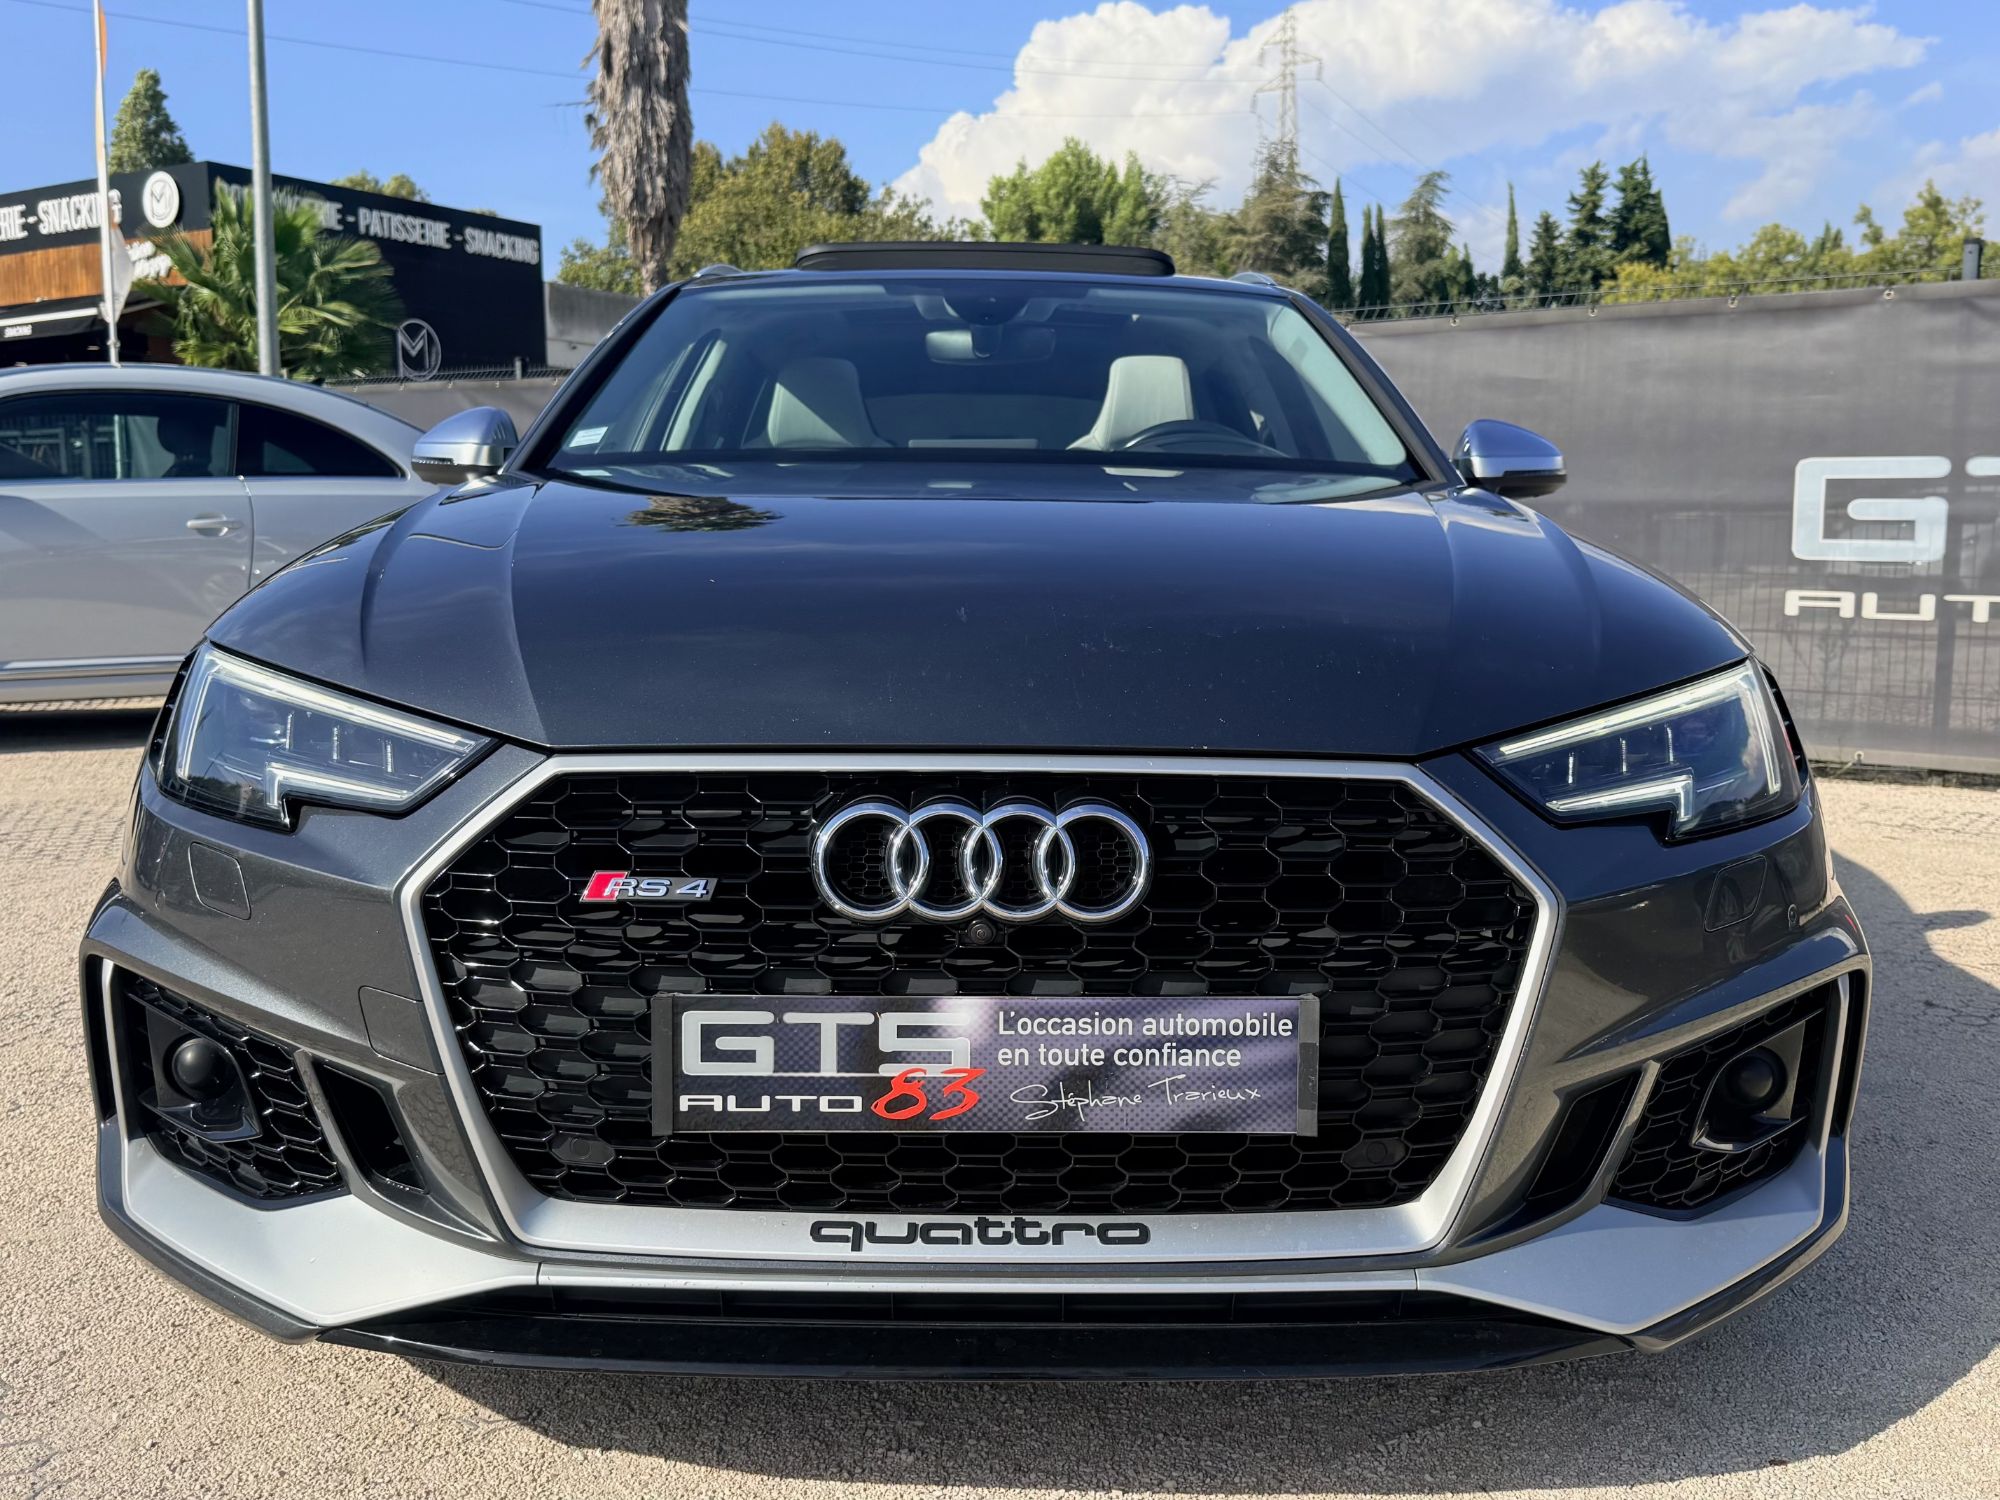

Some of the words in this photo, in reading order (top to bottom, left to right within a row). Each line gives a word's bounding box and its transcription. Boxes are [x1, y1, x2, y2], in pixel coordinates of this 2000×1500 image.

[38, 188, 122, 235] SNACKIG
[358, 207, 452, 250] PATISSERIE
[464, 226, 540, 266] SNACKING
[1791, 456, 2000, 562] G
[681, 1010, 971, 1077] GTS
[998, 1011, 1134, 1036] L'occasion
[1142, 1012, 1293, 1037] automobile
[997, 1047, 1030, 1066] en
[1038, 1043, 1105, 1067] toute
[1113, 1043, 1242, 1067] confiance
[679, 1095, 864, 1113] AUTO
[870, 1067, 987, 1121] 83
[810, 1216, 1151, 1252] quattro
